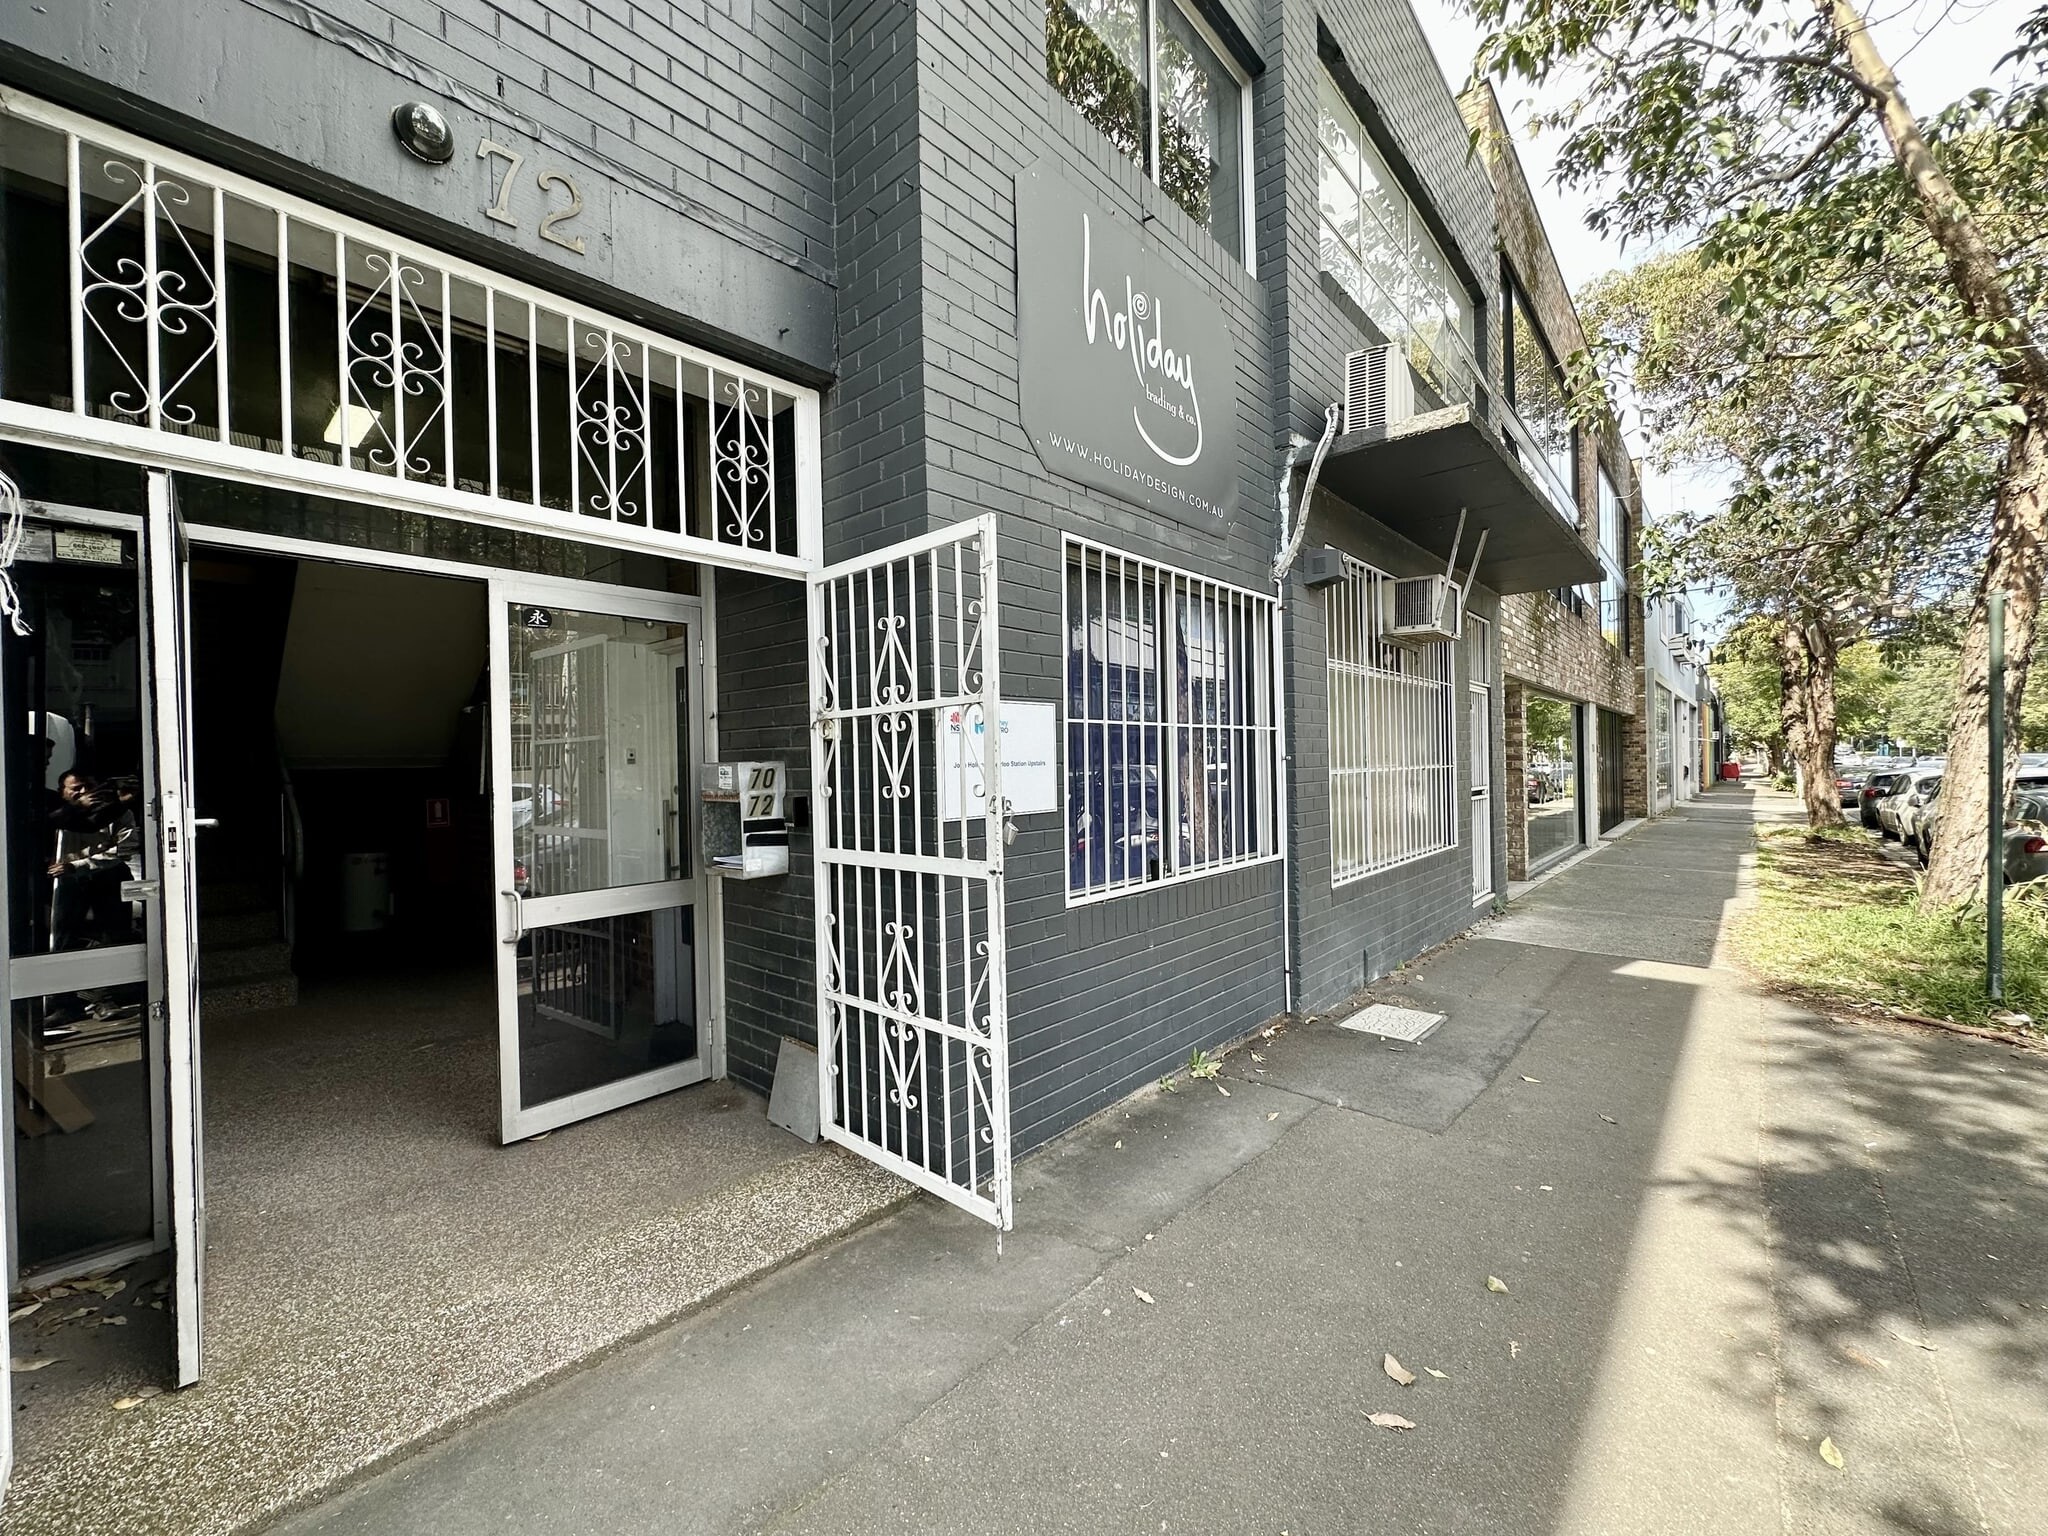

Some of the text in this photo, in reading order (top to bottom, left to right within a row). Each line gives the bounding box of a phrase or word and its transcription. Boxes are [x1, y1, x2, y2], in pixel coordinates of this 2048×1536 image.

[476, 136, 586, 256] 72
[1083, 213, 1203, 466] holiday
[1145, 383, 1197, 426] trading & co.
[1049, 431, 1224, 519] WWW.HOLIDAYDESIGN.COM.AU
[527, 609, 549, 625] 永
[751, 768, 775, 789] 70
[749, 795, 774, 816] 72
